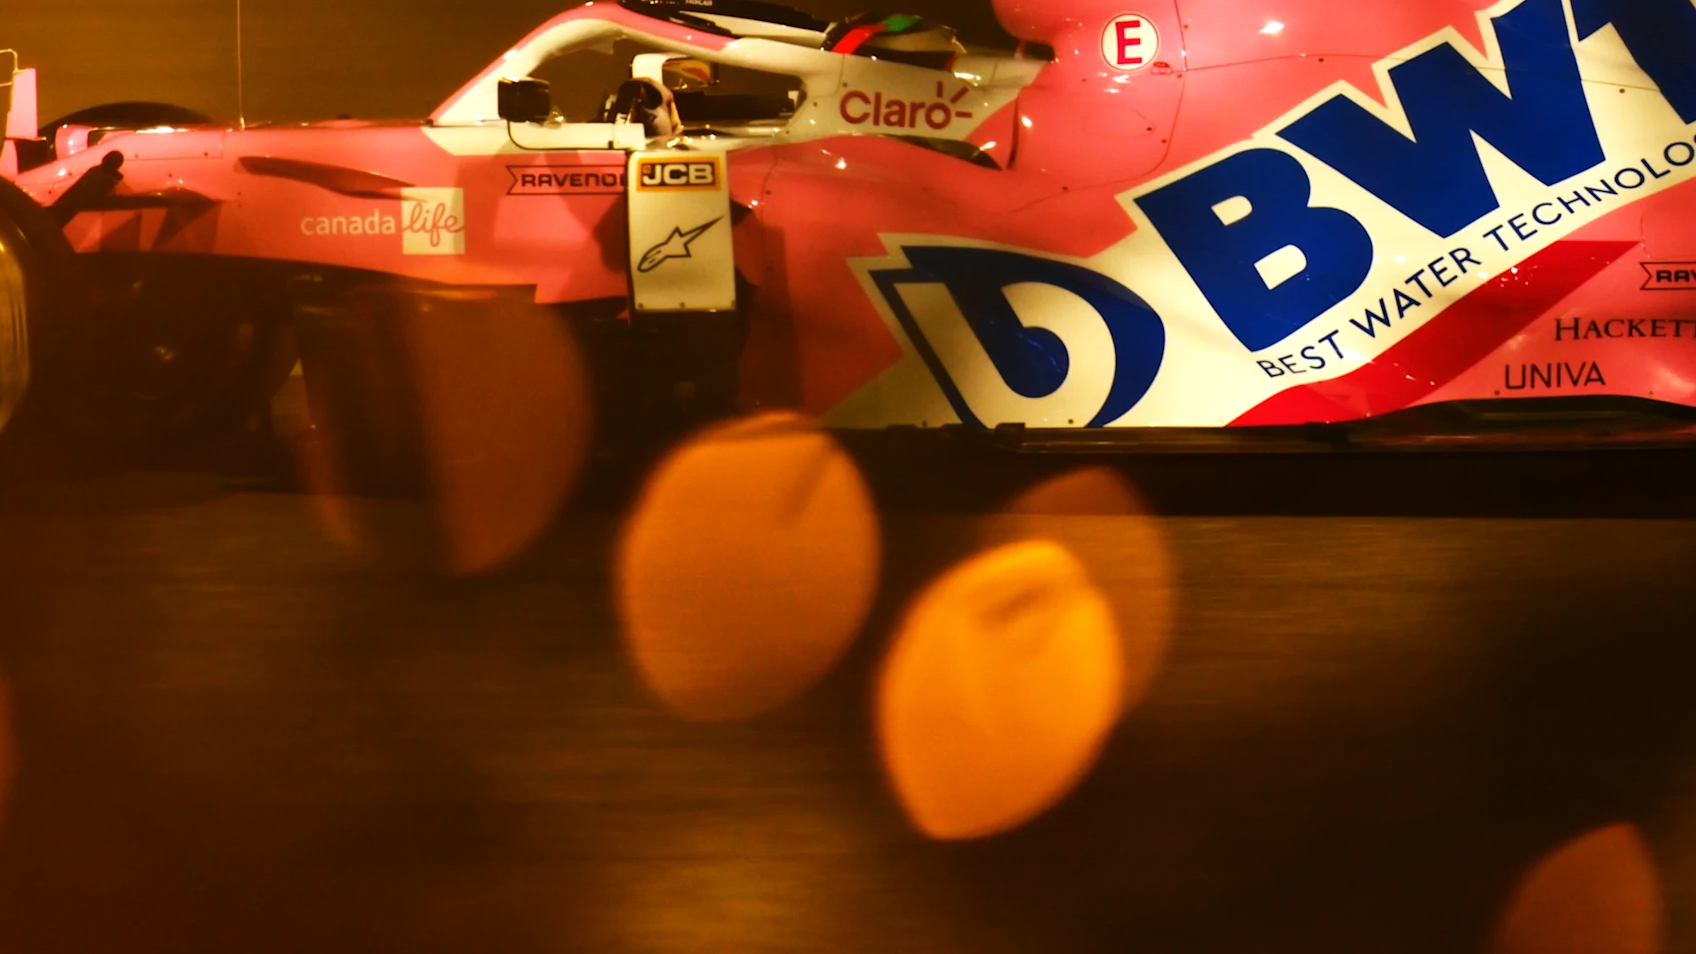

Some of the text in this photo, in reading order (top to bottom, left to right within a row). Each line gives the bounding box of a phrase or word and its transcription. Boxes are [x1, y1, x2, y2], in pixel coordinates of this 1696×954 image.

[1115, 20, 1143, 65] E
[839, 89, 952, 130] Claro
[642, 163, 714, 185] JCB
[301, 202, 464, 247] canada life
[1256, 133, 1696, 378] BEST WATER TECHNOLO
[1505, 361, 1606, 389] UNIVA
